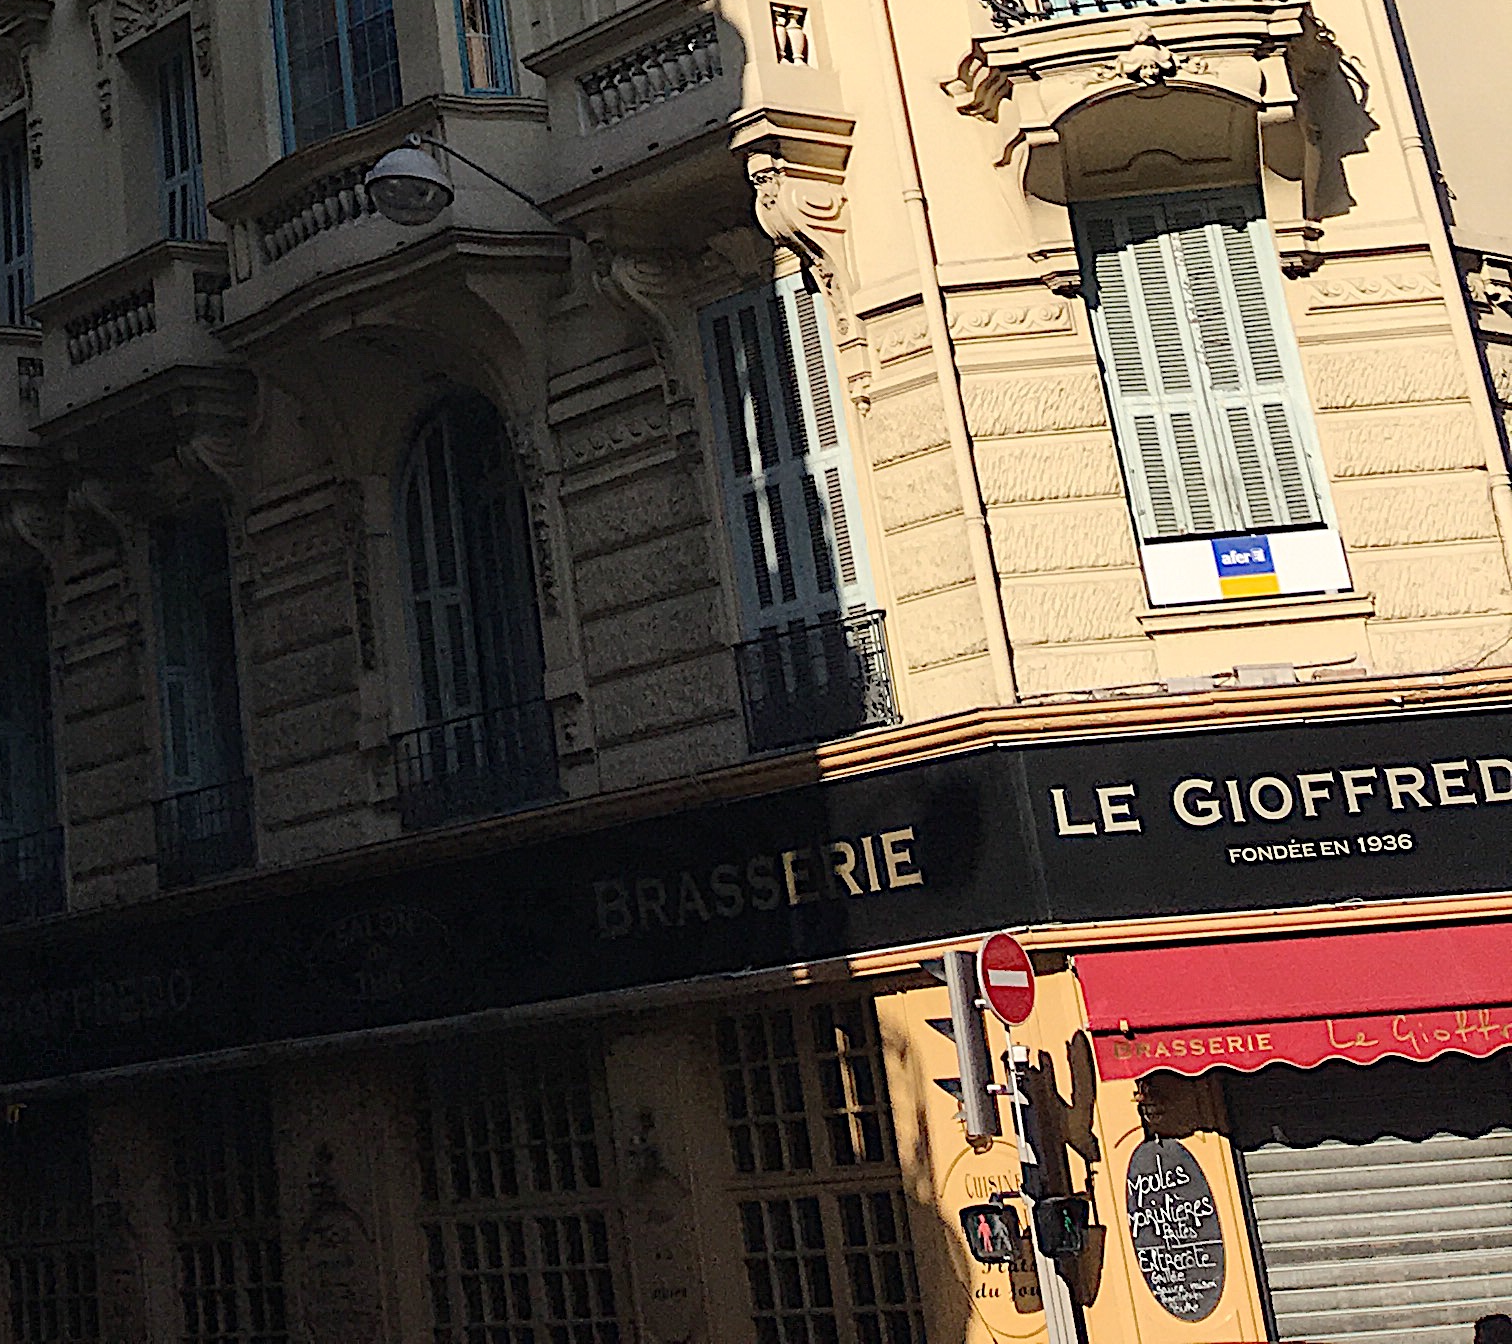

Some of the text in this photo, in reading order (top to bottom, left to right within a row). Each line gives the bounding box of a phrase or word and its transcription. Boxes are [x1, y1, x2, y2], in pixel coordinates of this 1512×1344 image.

[1049, 784, 1142, 836] LE
[1228, 833, 1414, 864] FONDÉE EN 1936
[592, 825, 925, 940] BRASSERIE
[1113, 1032, 1274, 1060] BRASSERIE
[1327, 1019, 1379, 1049] Le
[976, 1283, 1001, 1299] du
